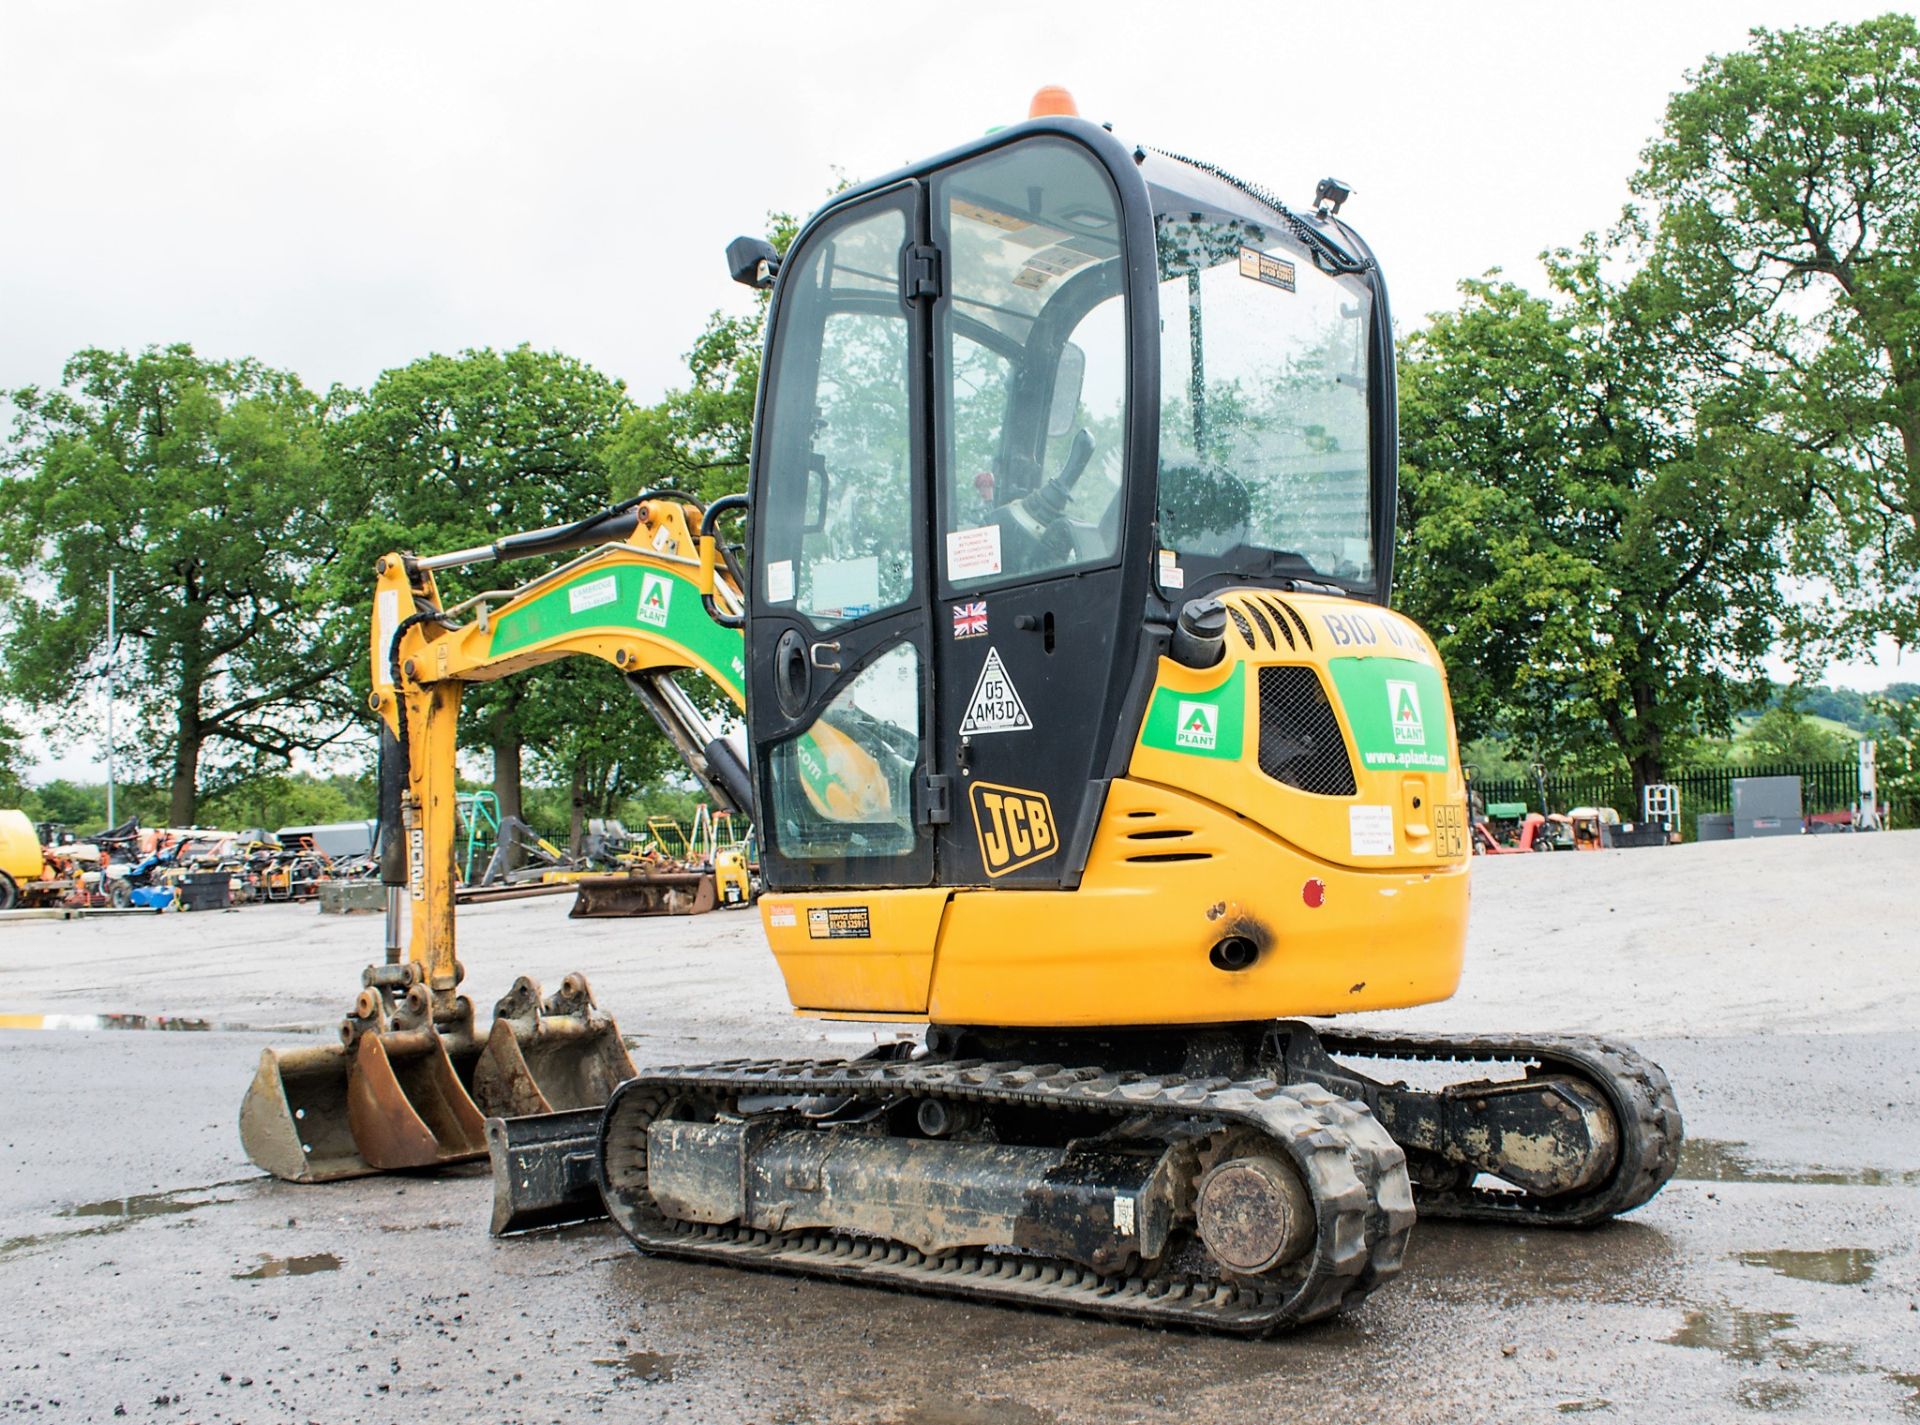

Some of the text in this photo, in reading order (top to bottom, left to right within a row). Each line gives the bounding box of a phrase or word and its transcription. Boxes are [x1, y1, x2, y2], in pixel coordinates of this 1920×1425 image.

[644, 581, 665, 609] A
[640, 608, 666, 623] PLANT
[1322, 614, 1376, 645] BIO
[986, 681, 1003, 699] 05
[977, 701, 1015, 722] AM3D
[1397, 688, 1419, 722] A
[1183, 708, 1211, 733] A
[1178, 734, 1214, 746] PLANT
[1395, 727, 1423, 740] PLANT
[1365, 749, 1446, 768] www.aplant.com
[983, 792, 1051, 866] JCB
[411, 829, 424, 901] 8025
